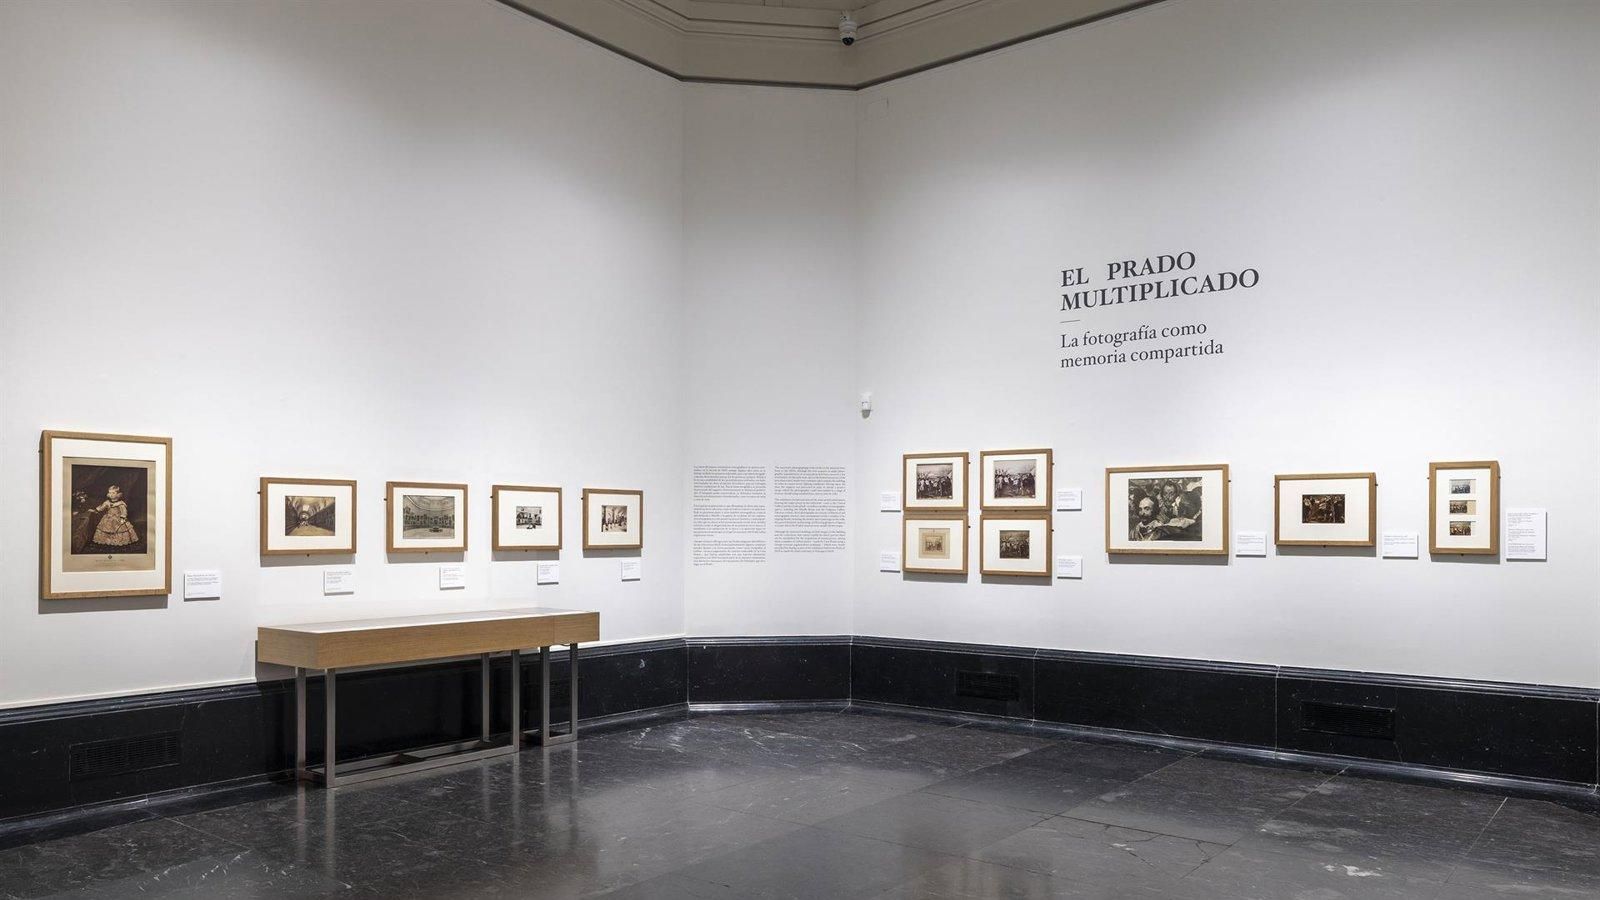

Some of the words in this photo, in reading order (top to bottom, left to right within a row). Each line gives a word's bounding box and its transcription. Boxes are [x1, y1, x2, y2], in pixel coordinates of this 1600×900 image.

[1061, 267, 1089, 287] EL
[1107, 251, 1196, 281] PRADO
[1060, 268, 1260, 311] MULTIPLICADO
[1060, 334, 1079, 349] La
[1082, 325, 1157, 348] fotografía
[1161, 323, 1207, 339] como
[1060, 350, 1126, 369] memoria
[1130, 340, 1224, 364] compartida
